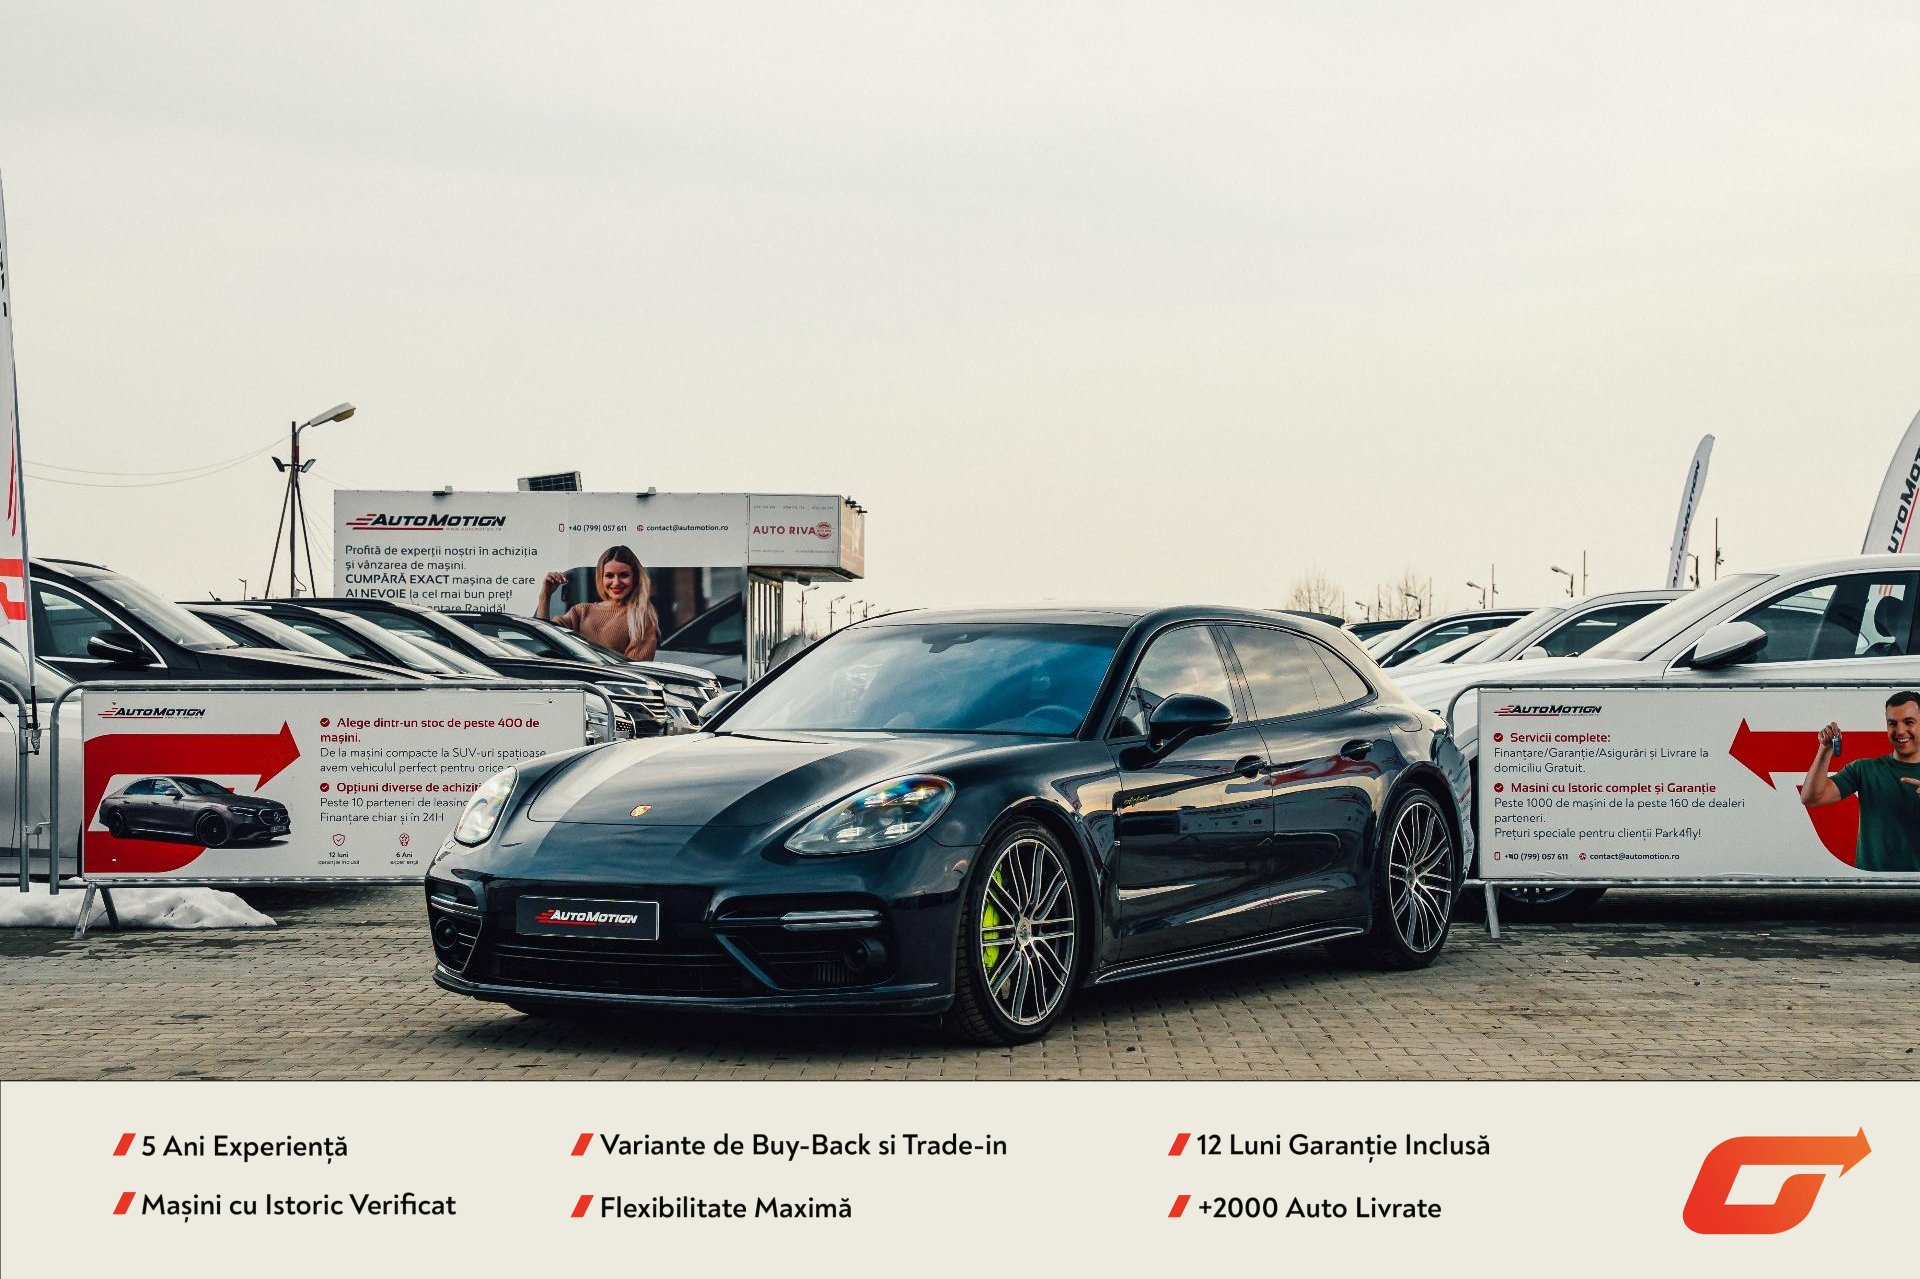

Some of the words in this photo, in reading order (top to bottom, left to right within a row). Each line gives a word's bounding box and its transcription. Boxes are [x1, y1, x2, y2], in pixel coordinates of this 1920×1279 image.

[568, 524, 582, 532] +40
[583, 523, 601, 533] (799)
[602, 524, 616, 532] 057
[616, 524, 627, 532] 611
[646, 524, 729, 533] contact@automotion.ro
[752, 525, 786, 535] AUTO
[788, 526, 817, 536] RIVA
[345, 544, 381, 556] Profită
[384, 546, 398, 556] de
[400, 546, 442, 557] experții
[444, 546, 476, 558] noștri
[478, 545, 489, 556] în
[491, 546, 538, 558] achiziția
[345, 559, 355, 572] și
[357, 559, 408, 570] vânzarea
[410, 560, 425, 570] de
[427, 560, 466, 572] mașini.
[345, 573, 407, 585] CUMPĂRĂ
[409, 574, 451, 585] EXACT
[452, 574, 493, 587] mașina
[495, 574, 509, 585] de
[511, 577, 536, 585] care
[345, 588, 358, 599] AI
[360, 588, 407, 599] NEVOIE
[409, 588, 419, 599] la
[421, 588, 438, 599] cel
[440, 588, 461, 599] mai
[464, 589, 485, 599] bun
[488, 589, 513, 603] preț!
[336, 717, 371, 730] Alege
[373, 717, 418, 728] dintr-un
[420, 718, 445, 728] stoc
[446, 717, 462, 728] de
[463, 719, 496, 730] peste
[497, 717, 523, 728] 400
[525, 717, 540, 728] de
[320, 732, 361, 744] mașini.
[1510, 732, 1552, 743] Servicii
[1554, 732, 1611, 745] complete:
[319, 747, 336, 758] De
[338, 747, 347, 758] la
[348, 746, 383, 761] mașini
[385, 746, 439, 760] compacte
[440, 747, 450, 758] la
[452, 747, 495, 761] SUV-uri
[1649, 748, 1657, 761] și
[1660, 747, 1697, 758] Livrare
[1699, 747, 1709, 758] la
[319, 764, 348, 774] avem
[350, 761, 396, 773] vehiculul
[398, 761, 438, 775] perfect
[440, 763, 475, 775] pentru
[477, 762, 503, 773] orice
[1493, 762, 1542, 773] domiciliu
[1544, 762, 1586, 773] Gratuit.
[336, 782, 379, 795] Opțiuni
[381, 782, 423, 794] diverse
[425, 782, 440, 793] de
[1551, 784, 1566, 793] cu
[1568, 782, 1603, 793] Istoric
[1605, 782, 1652, 795] complet
[1654, 782, 1665, 795] și
[1667, 782, 1717, 795] Garanție
[320, 797, 350, 808] Peste
[351, 797, 364, 808] 10
[366, 797, 415, 810] parteneri
[417, 796, 431, 808] de
[1494, 797, 1524, 808] Peste
[1526, 797, 1553, 808] 1000
[1555, 797, 1570, 808] de
[1572, 798, 1606, 811] mașini
[1608, 797, 1623, 808] de
[1625, 797, 1635, 808] la
[1637, 799, 1668, 811] peste
[1669, 798, 1689, 808] 160
[1691, 797, 1706, 808] de
[1708, 797, 1745, 809] dealeri
[320, 811, 370, 826] Finanțare
[371, 811, 398, 823] chiar
[399, 812, 408, 826] și
[409, 812, 420, 822] în
[422, 811, 444, 822] 24H
[1494, 813, 1547, 826] parteneri.
[1494, 827, 1531, 841] Prețuri
[1532, 826, 1576, 841] speciale
[1578, 828, 1615, 841] pentru
[1617, 827, 1652, 842] clienții
[1655, 826, 1704, 841] Park4fly!
[328, 851, 336, 859] 12
[402, 851, 413, 859] Ani
[1520, 851, 1540, 862] (799)
[1541, 852, 1555, 861] 057
[1557, 852, 1569, 861] 611
[1589, 852, 1680, 862] contact@automotion.ro
